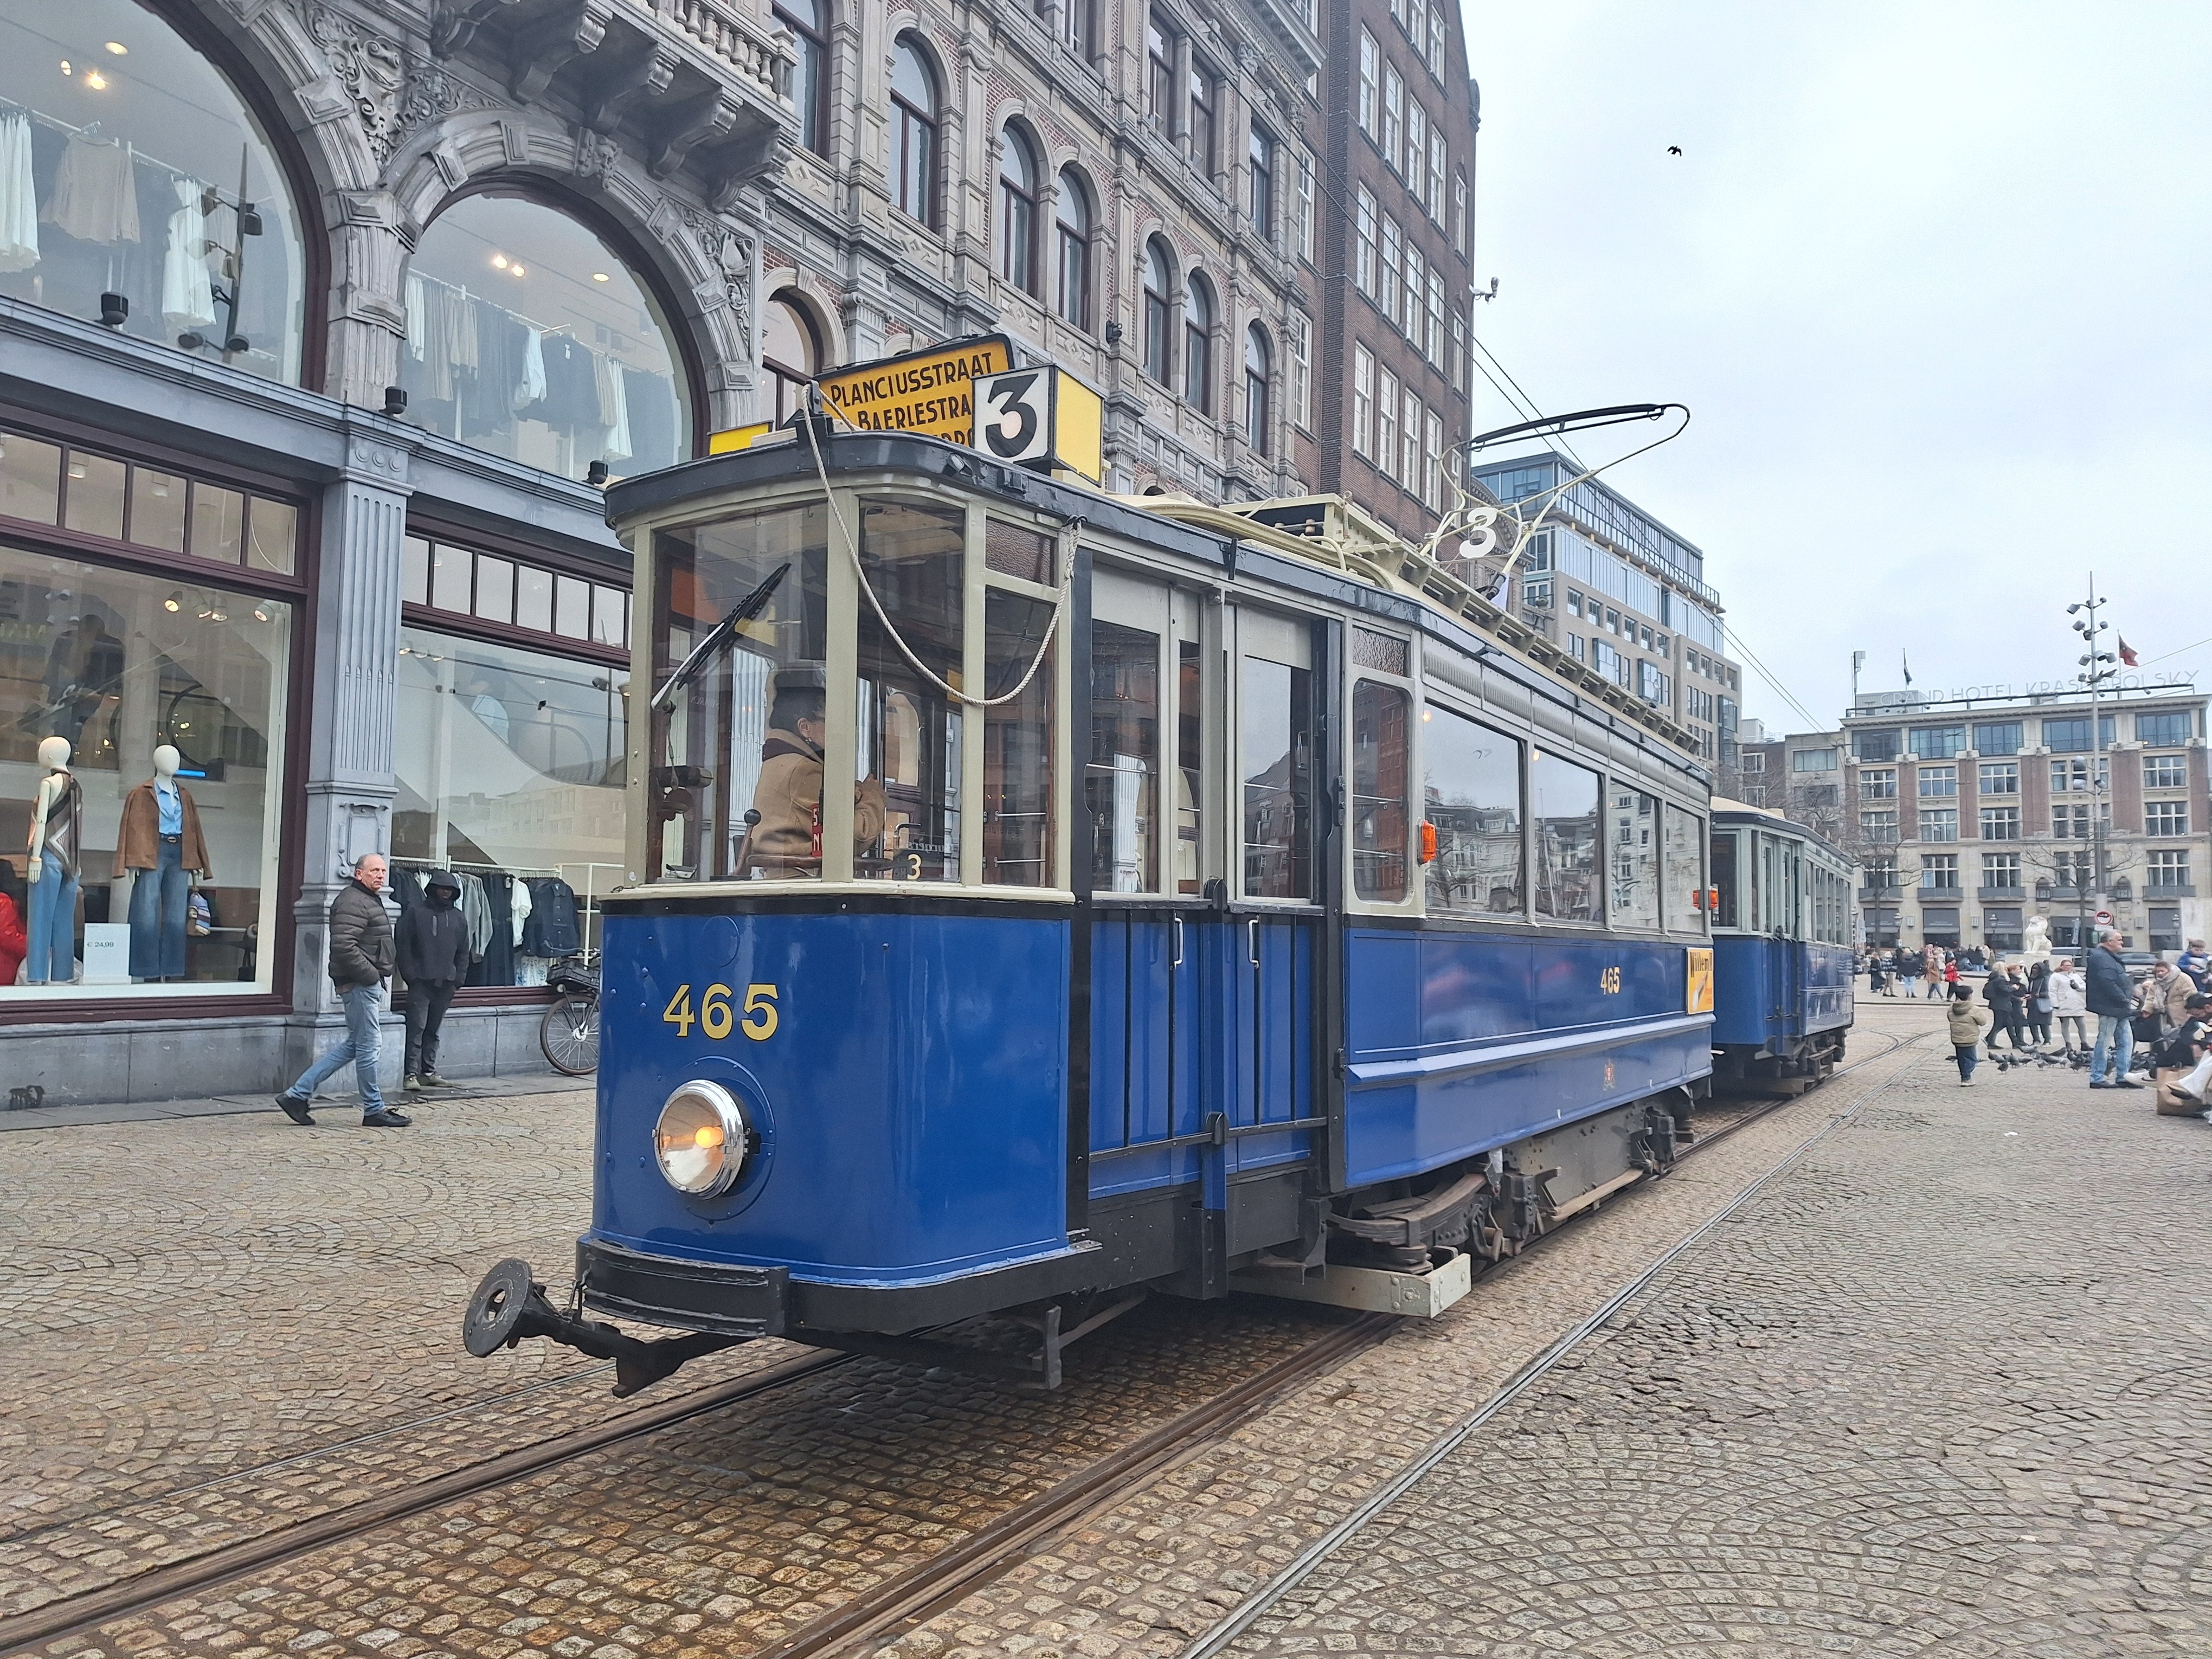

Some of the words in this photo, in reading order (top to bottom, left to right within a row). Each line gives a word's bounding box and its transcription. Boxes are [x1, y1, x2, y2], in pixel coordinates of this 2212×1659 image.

[830, 352, 992, 407] PLANCIUSSTRAAT
[858, 394, 972, 430] BAERLESTRA
[985, 374, 1039, 458] 3
[1459, 507, 1497, 558] 3
[1881, 690, 1944, 704] GRAND
[907, 853, 921, 880] 3
[1600, 967, 1621, 995] 465
[663, 983, 779, 1041] 465
